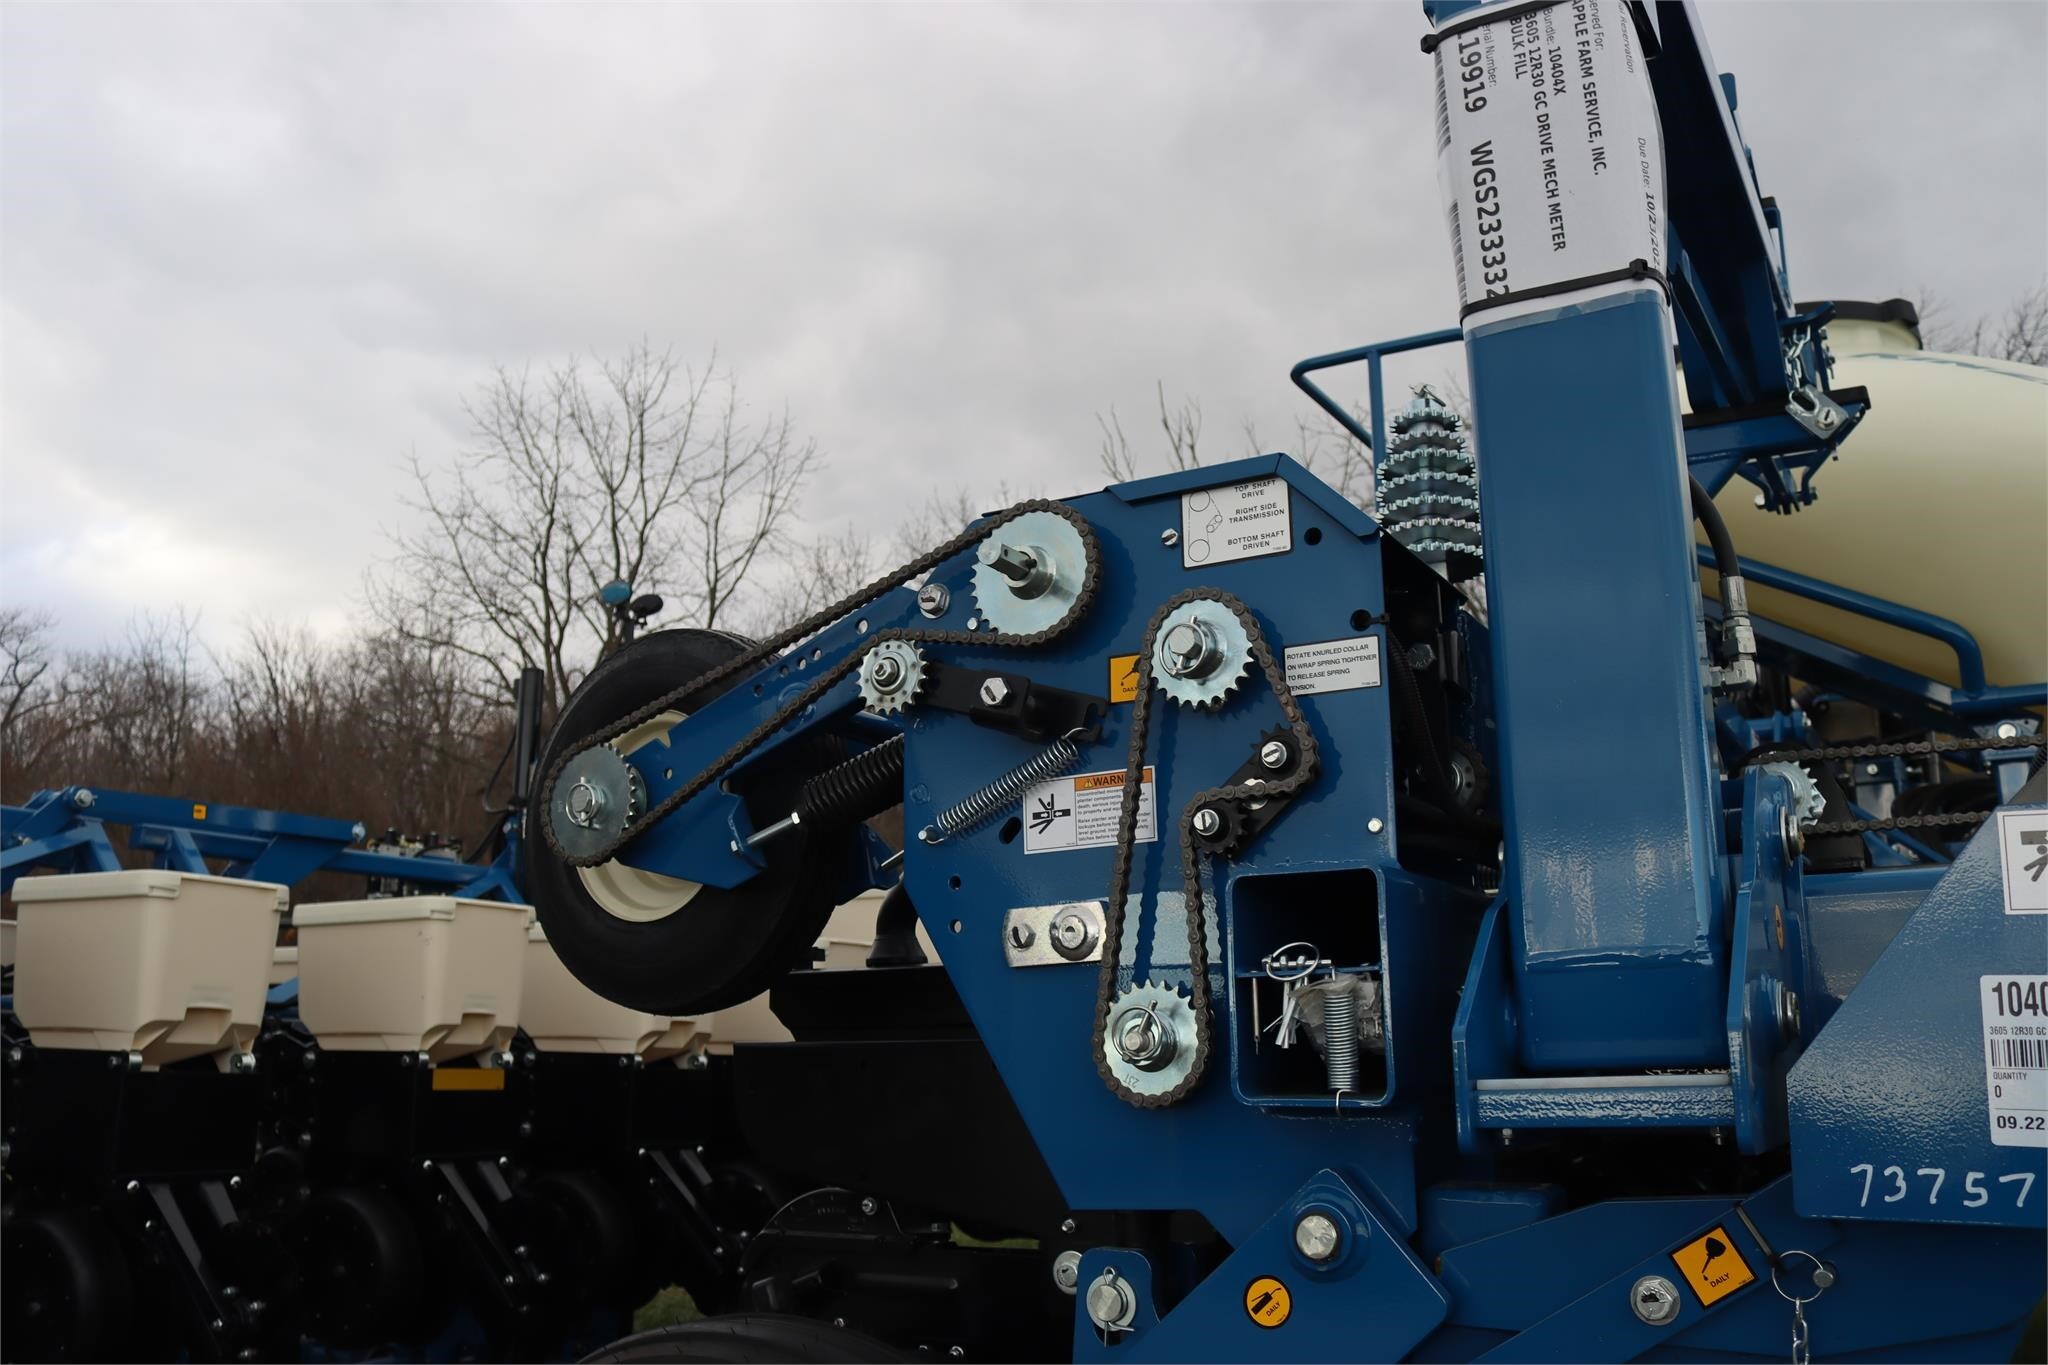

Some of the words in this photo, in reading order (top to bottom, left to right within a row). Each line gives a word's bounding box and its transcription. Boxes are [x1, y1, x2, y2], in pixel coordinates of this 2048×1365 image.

[1482, 24, 1494, 44] erial
[1510, 17, 1524, 50] BULK
[1594, 32, 1604, 51] For:
[1486, 45, 1496, 87] Number:
[1514, 52, 1528, 80] FILL
[1529, 46, 1544, 88] 12R30
[1577, 40, 1594, 78] FARM
[1458, 33, 1487, 112] 19919
[1548, 46, 1566, 96] 10404X
[1534, 91, 1548, 110] GC
[1582, 82, 1602, 143] SERVICE,
[1537, 114, 1554, 155] DRIVE
[1638, 137, 1646, 158] Due
[1592, 146, 1606, 176] INC.
[1542, 158, 1560, 199] MECH
[1641, 160, 1650, 188] Date:
[1548, 202, 1566, 252] METER
[1646, 192, 1660, 268] 10/23/202
[1242, 489, 1264, 499] DRIVE
[1252, 480, 1276, 489] SHAFT
[1229, 509, 1284, 523] TRANSMISSION
[1236, 506, 1258, 515] RIGHT
[1228, 535, 1258, 545] BOTTOM
[1261, 530, 1285, 540] SHAFT
[1242, 541, 1270, 550] DRIVEN
[1287, 652, 1311, 660] ROTATE
[1313, 648, 1342, 656] KNURLED
[1343, 644, 1368, 652] COLLAR
[1341, 654, 1377, 663] TIGHTENER
[1297, 671, 1325, 679] RELEASE
[1327, 668, 1350, 676] SPRING
[1093, 774, 1126, 786] WARN
[1990, 1026, 2008, 1035] 3605
[2011, 1026, 2033, 1035] 12R30
[2036, 1026, 2046, 1035] GC
[1993, 1072, 2027, 1080] QUANTITY
[1994, 1085, 2002, 1098] 0
[1710, 1273, 1730, 1288] DAILY
[1266, 1302, 1280, 1316] DAILY
